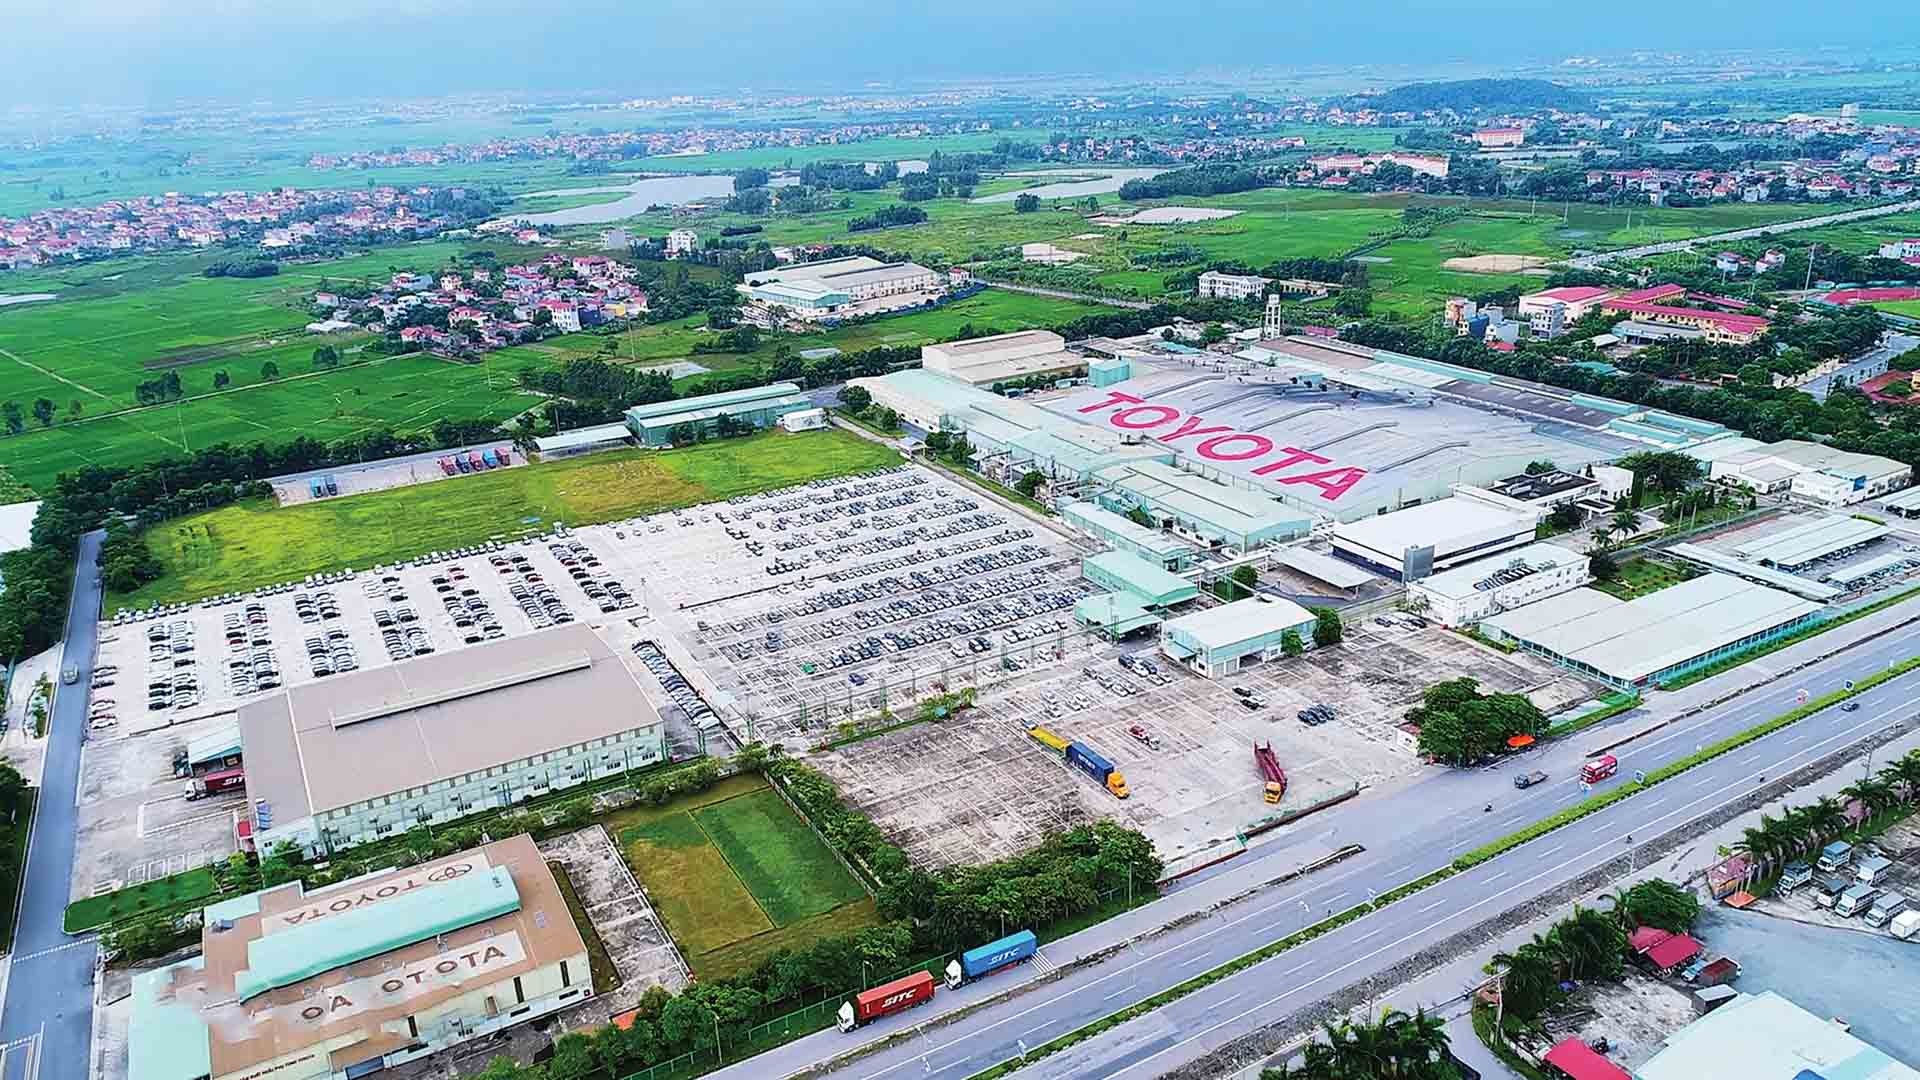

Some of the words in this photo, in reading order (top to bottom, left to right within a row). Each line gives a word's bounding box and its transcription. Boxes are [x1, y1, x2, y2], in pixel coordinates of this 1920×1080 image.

[1077, 391, 1369, 502] TOYOTA
[283, 879, 422, 925] TOYOTA
[988, 948, 1020, 965] SITC
[881, 988, 917, 1008] SITC
